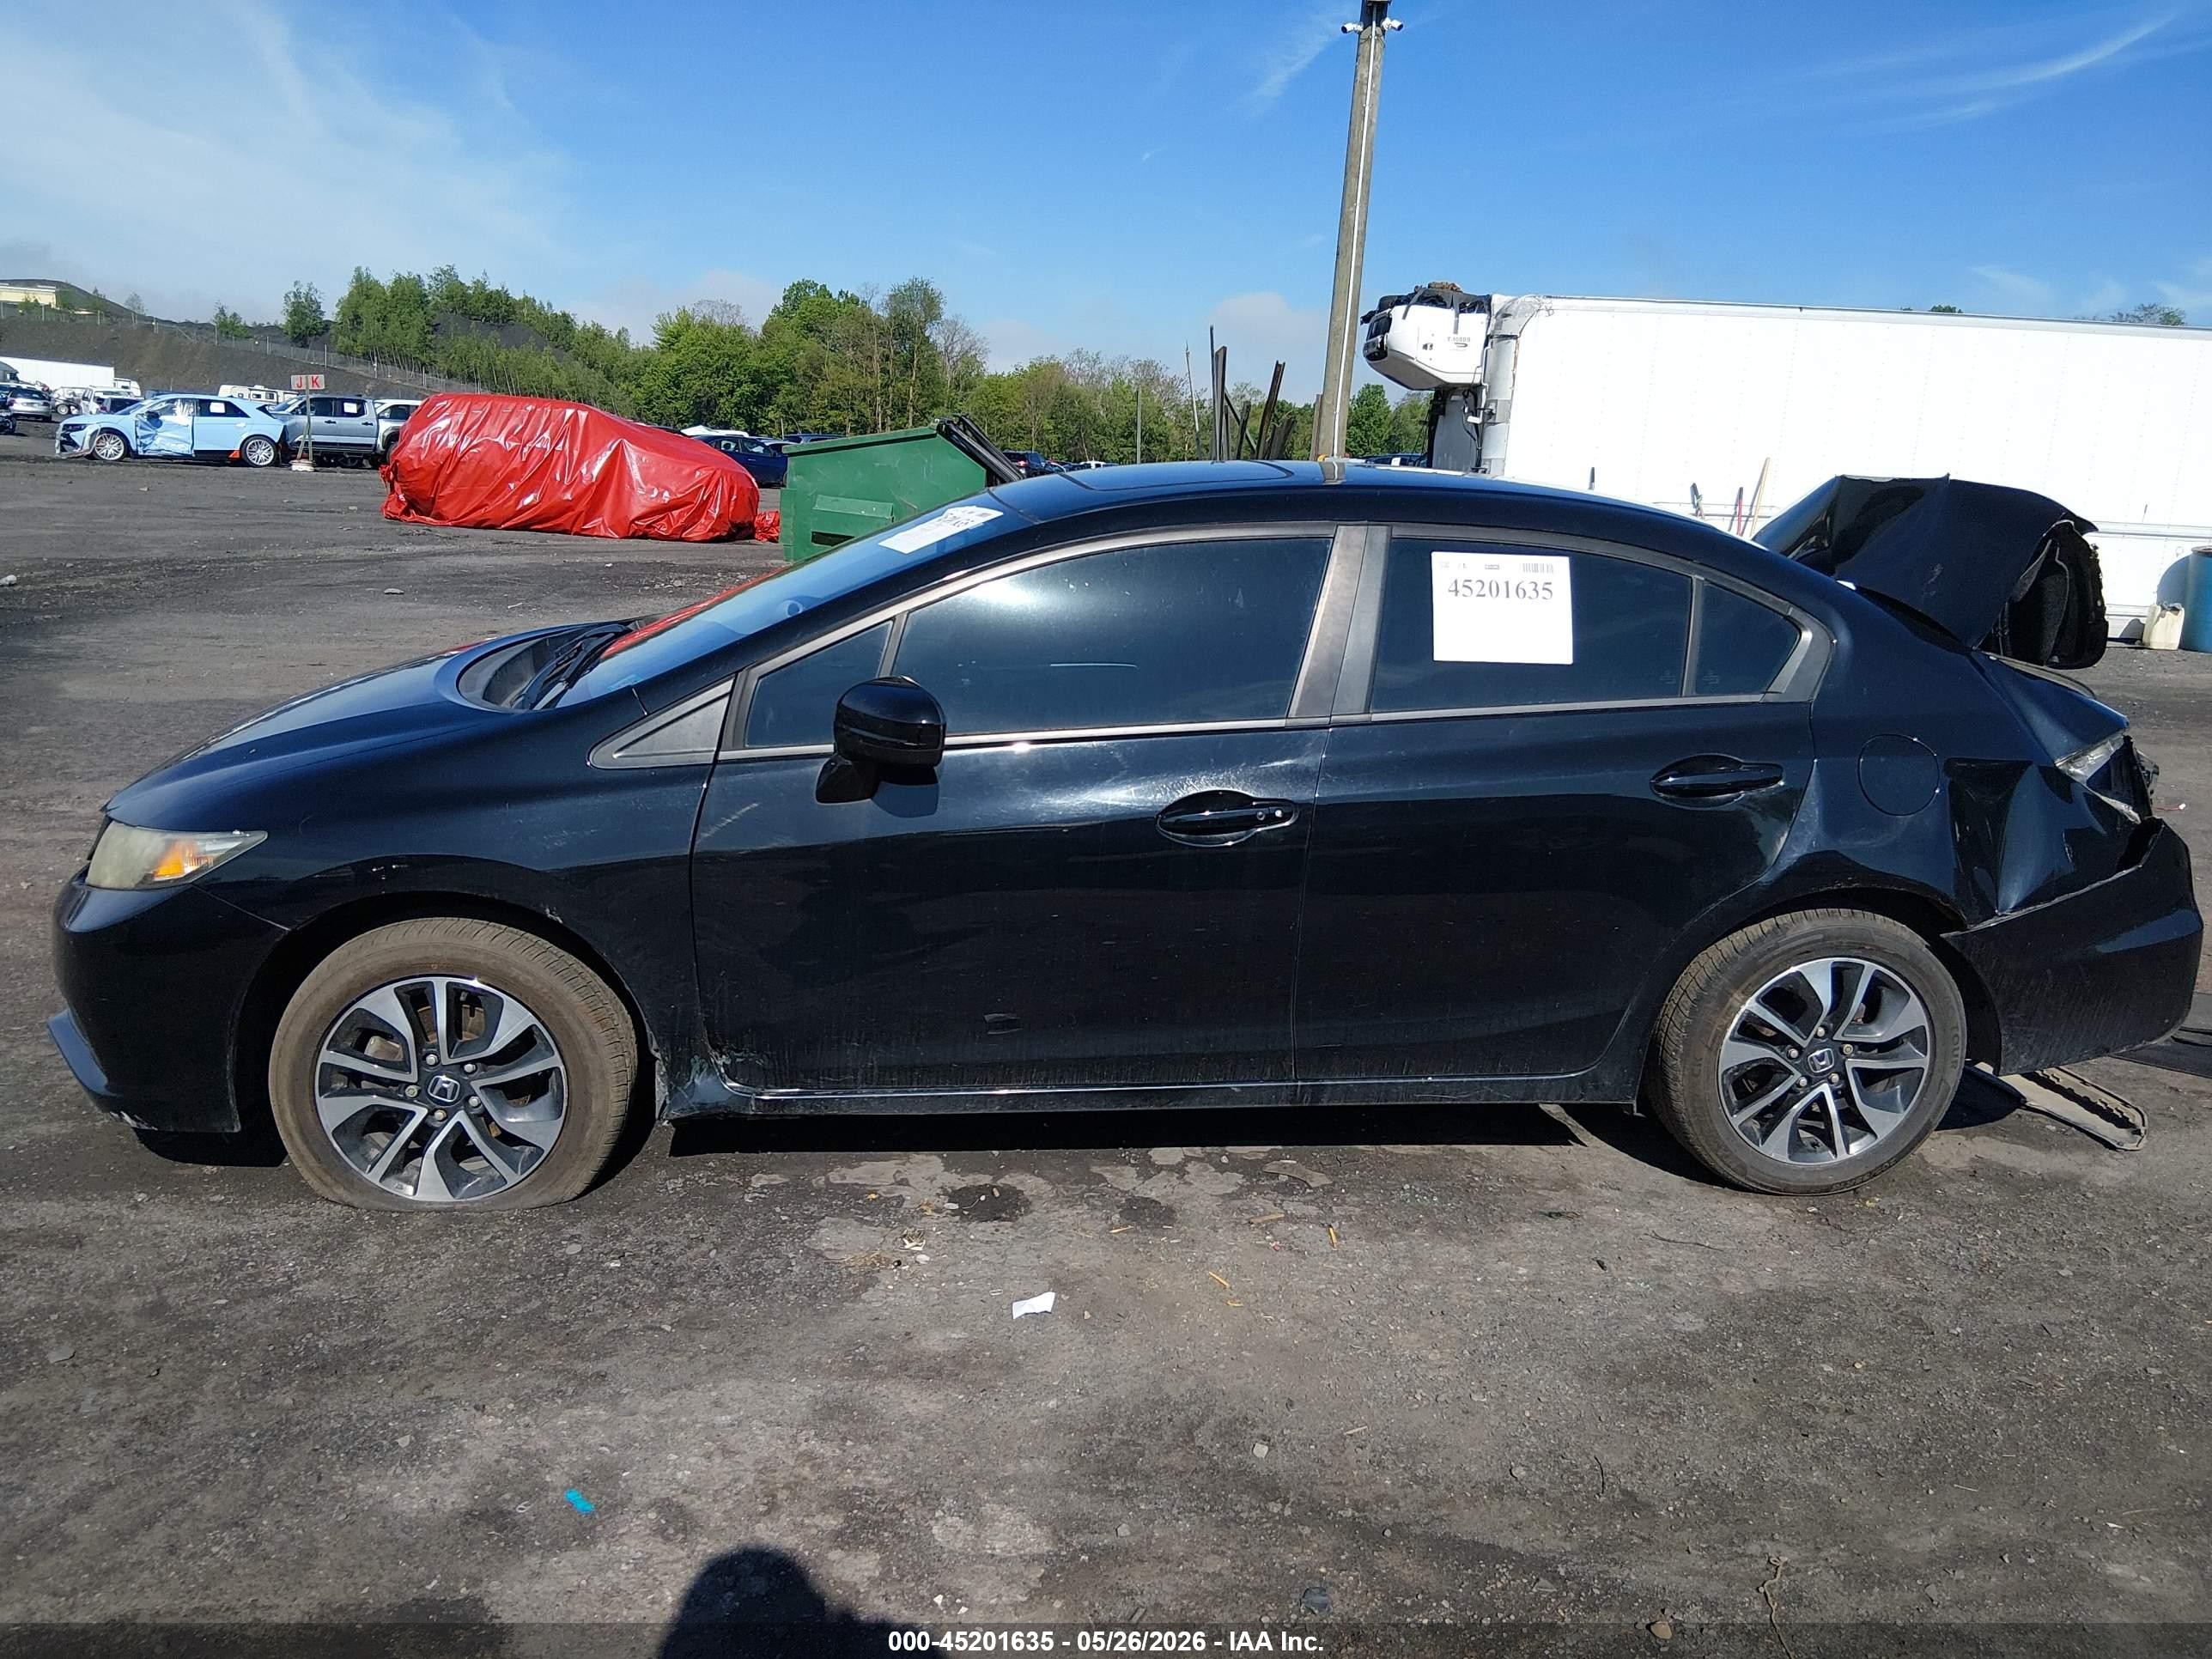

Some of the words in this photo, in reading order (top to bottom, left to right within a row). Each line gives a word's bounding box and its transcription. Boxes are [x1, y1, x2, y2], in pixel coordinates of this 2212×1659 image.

[296, 376, 302, 388] J
[311, 376, 320, 387] K
[1448, 578, 1553, 599] 45201635
